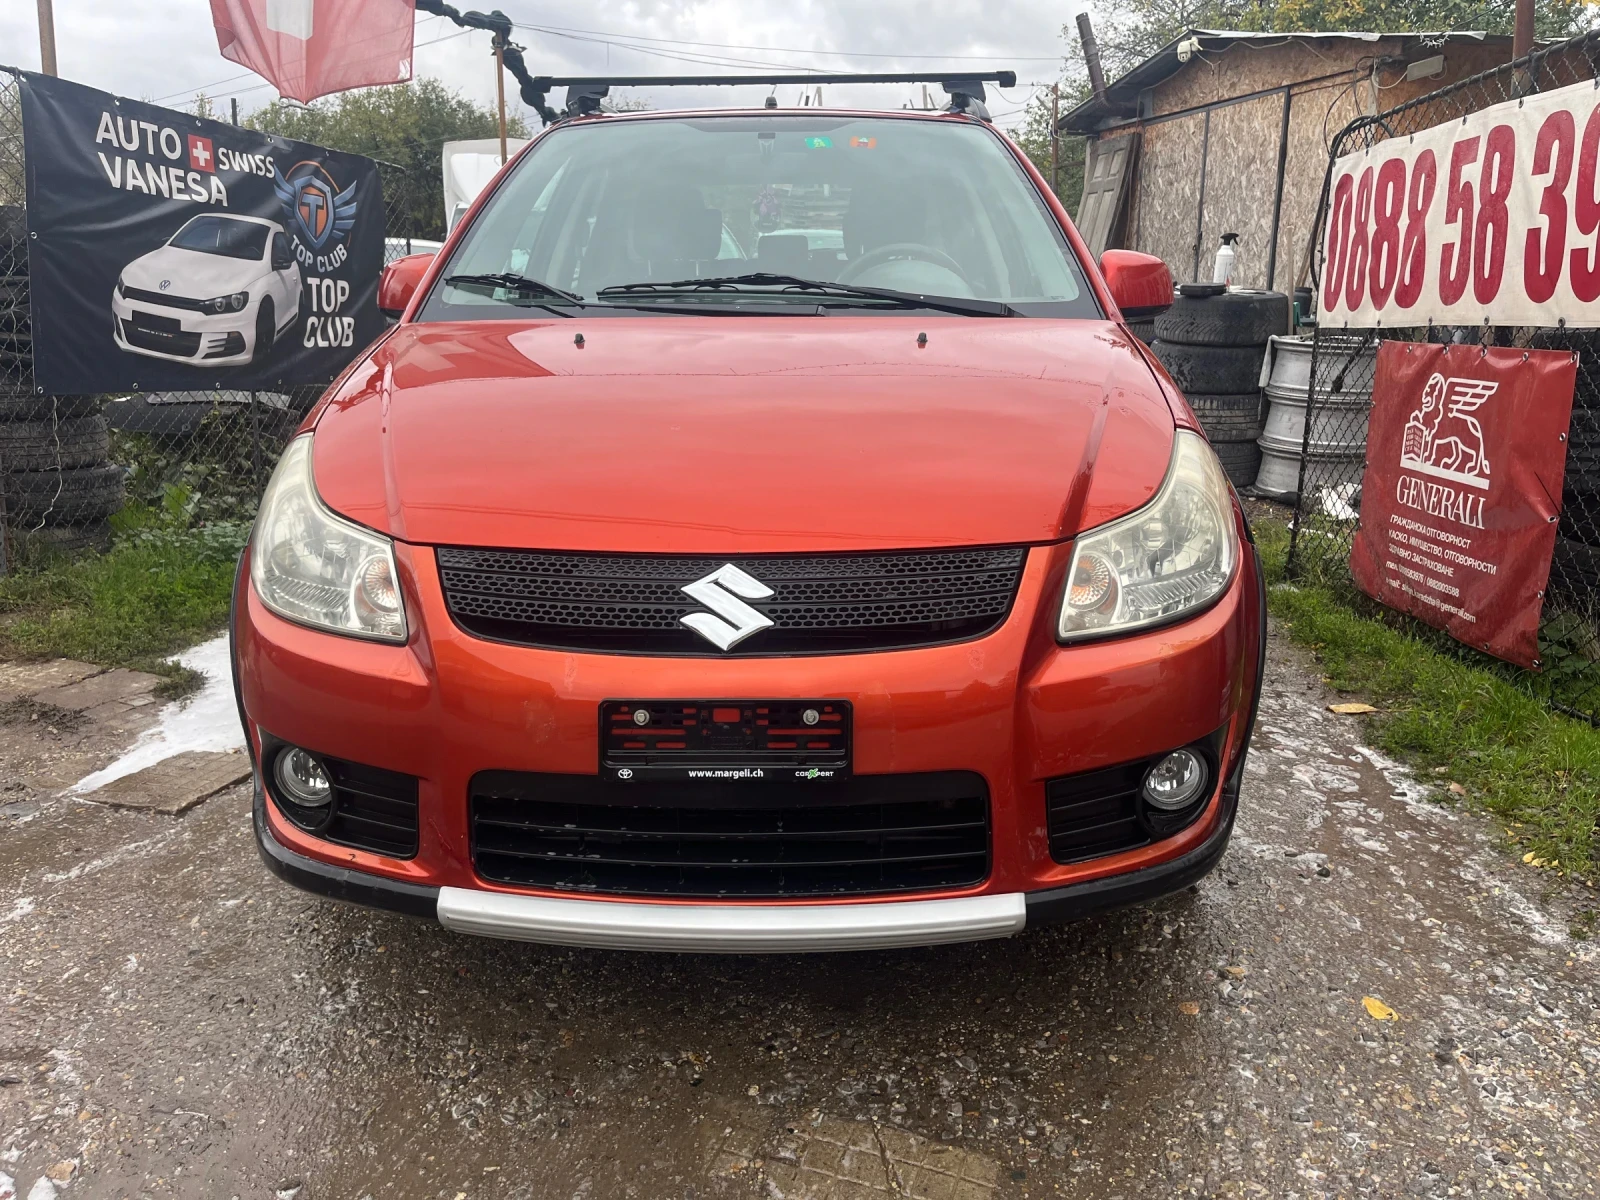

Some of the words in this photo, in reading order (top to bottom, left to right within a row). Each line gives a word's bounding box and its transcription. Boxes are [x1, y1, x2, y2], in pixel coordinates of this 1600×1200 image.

[95, 111, 182, 160] AUTO
[218, 147, 275, 178] SWISS
[98, 152, 228, 207] VANESA
[1324, 148, 1437, 312] 0888
[1438, 124, 1516, 306] 58
[290, 234, 314, 267] TOP
[316, 243, 348, 273] CLUB
[307, 277, 350, 313] TOP
[303, 316, 355, 348] CLUB
[1396, 475, 1486, 530] GENERALI
[1427, 527, 1471, 549] ОТГОВОРНОСТ
[1444, 549, 1497, 575] ОТГОВОРНОСТИ
[688, 768, 764, 780] www.margeli.ch
